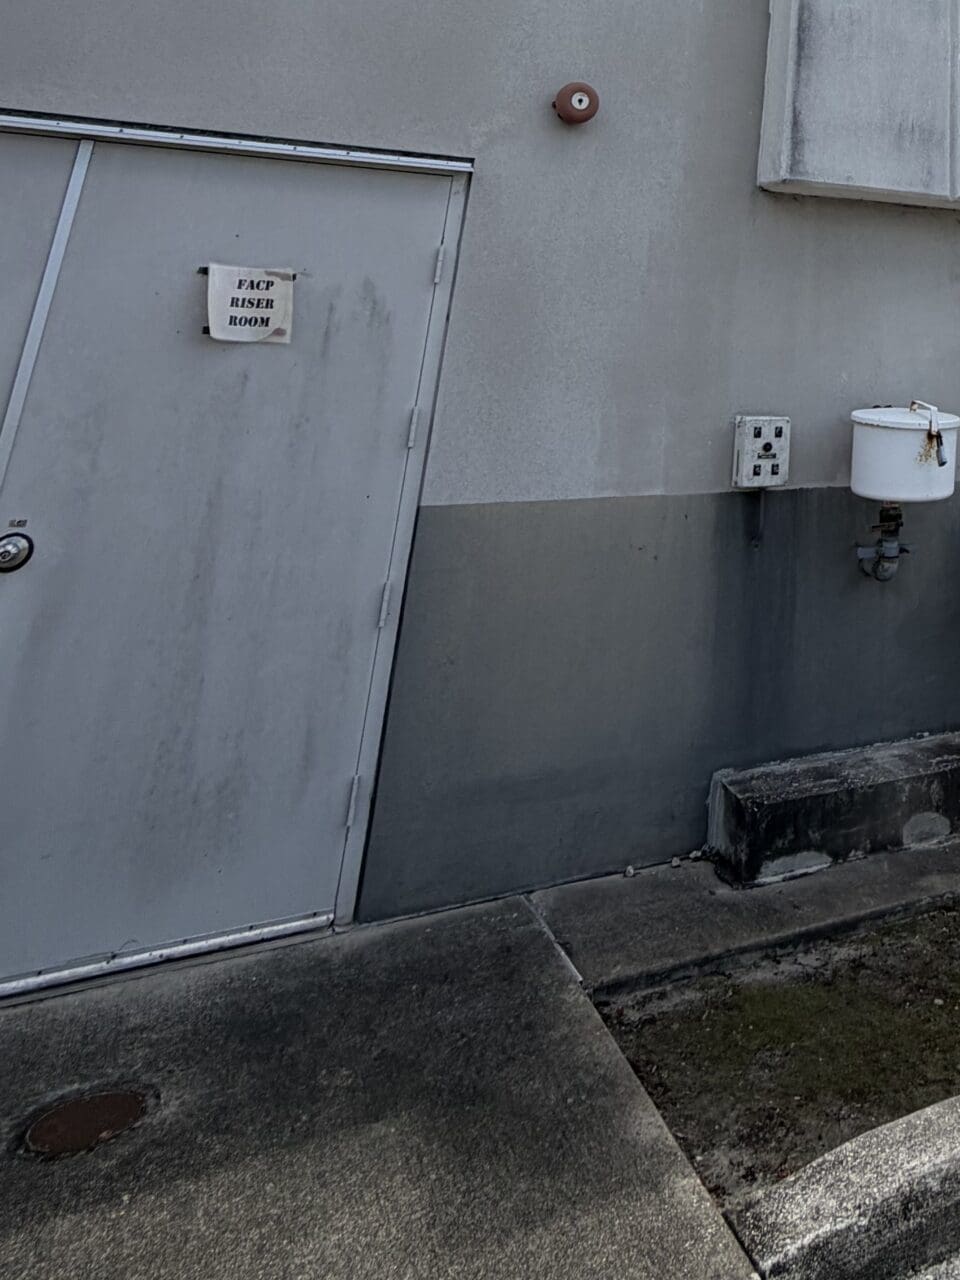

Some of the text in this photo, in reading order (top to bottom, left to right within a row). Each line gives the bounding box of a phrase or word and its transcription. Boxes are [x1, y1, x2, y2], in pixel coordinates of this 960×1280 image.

[237, 279, 274, 291] FACP
[229, 297, 274, 310] RISER
[228, 315, 271, 328] ROOM
